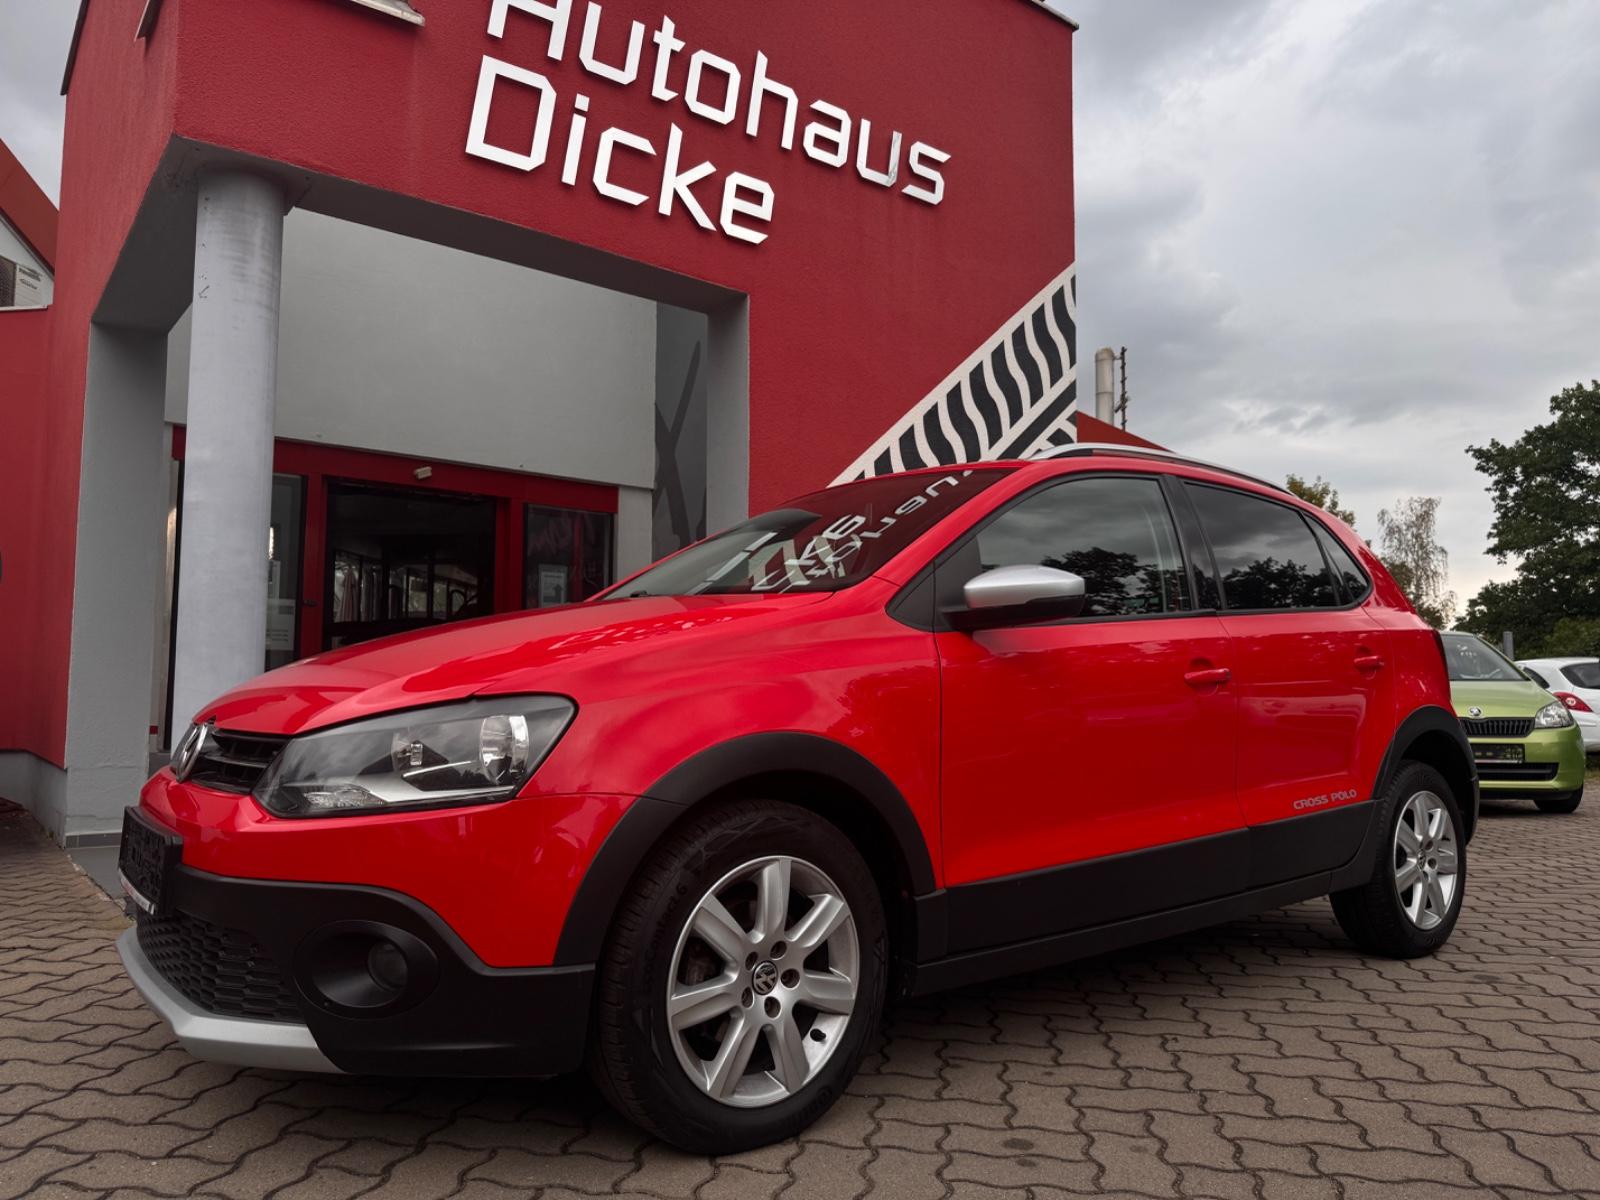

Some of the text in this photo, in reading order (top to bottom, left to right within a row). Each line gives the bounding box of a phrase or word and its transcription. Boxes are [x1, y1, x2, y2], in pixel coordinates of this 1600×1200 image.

[465, 54, 775, 245] Dicke
[487, 0, 951, 205] Autohaus
[1293, 788, 1357, 810] CROSS POLO
